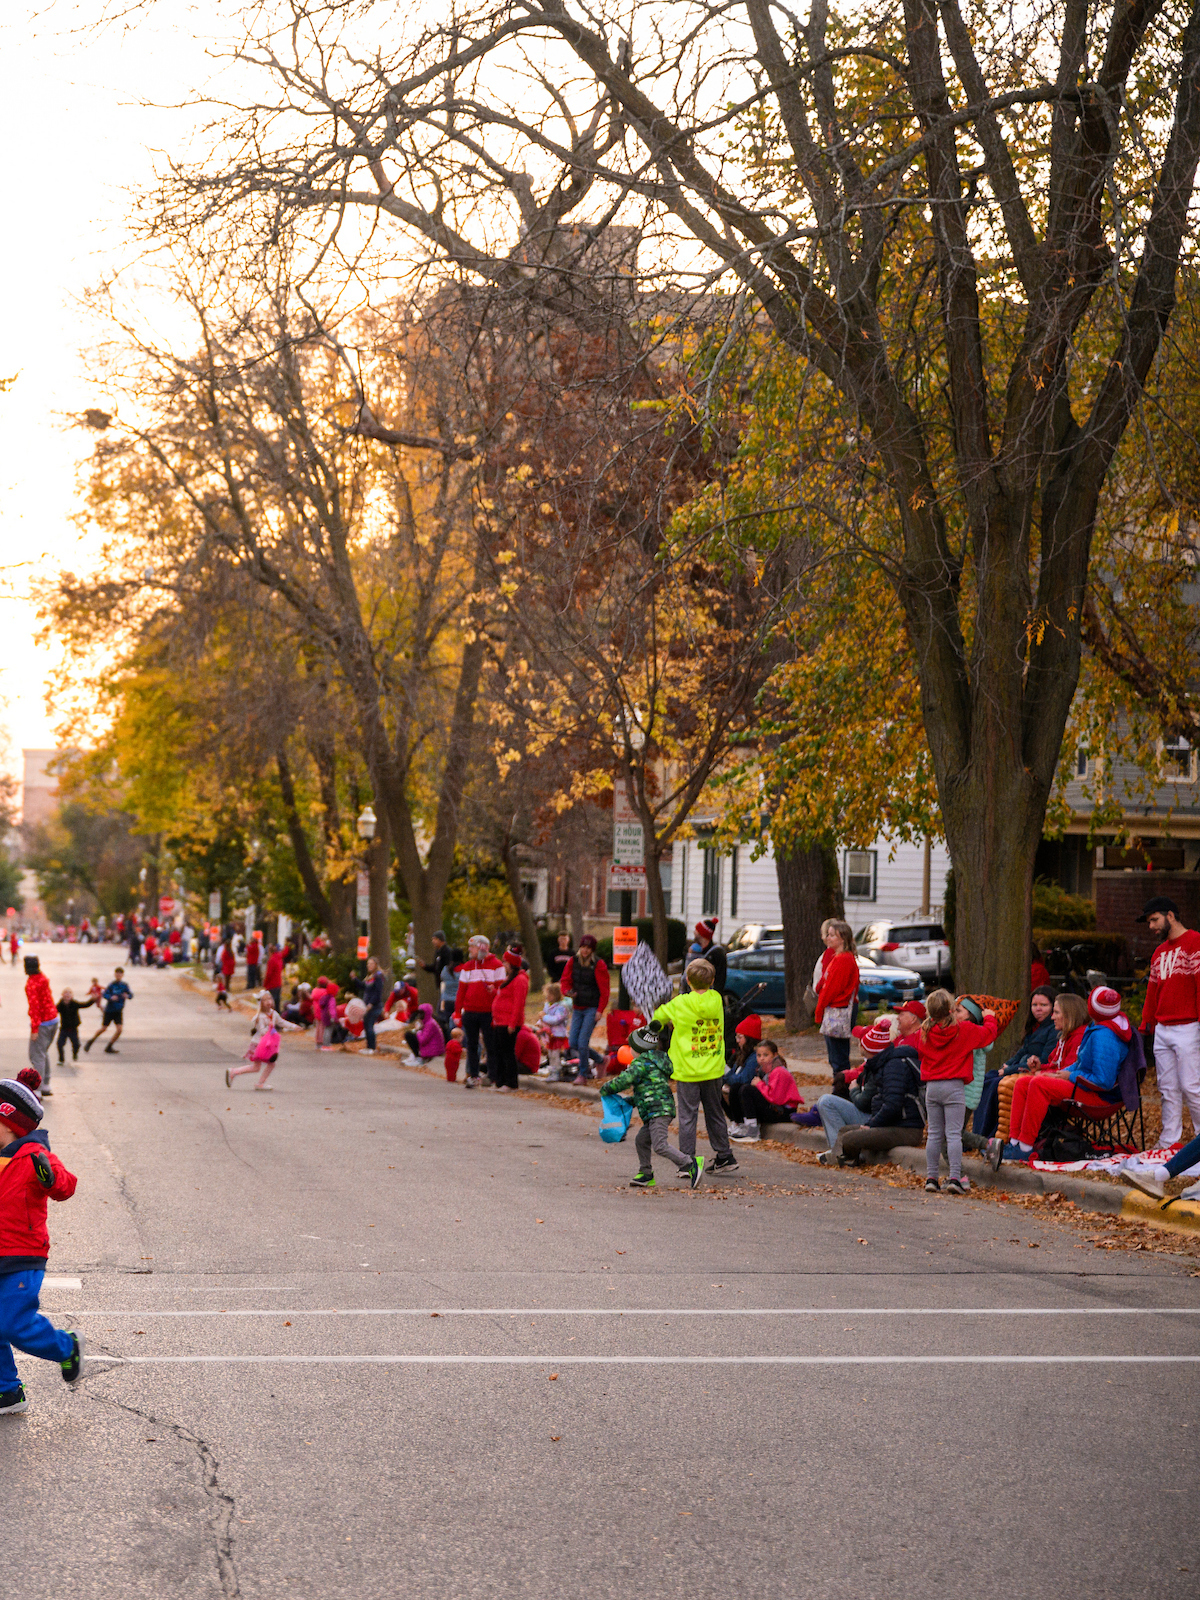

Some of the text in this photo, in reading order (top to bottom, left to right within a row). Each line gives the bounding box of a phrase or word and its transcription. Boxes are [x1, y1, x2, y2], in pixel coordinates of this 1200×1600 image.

[616, 827, 642, 836] 2 HOUR
[617, 838, 640, 846] PARKING
[1161, 946, 1182, 980] W
